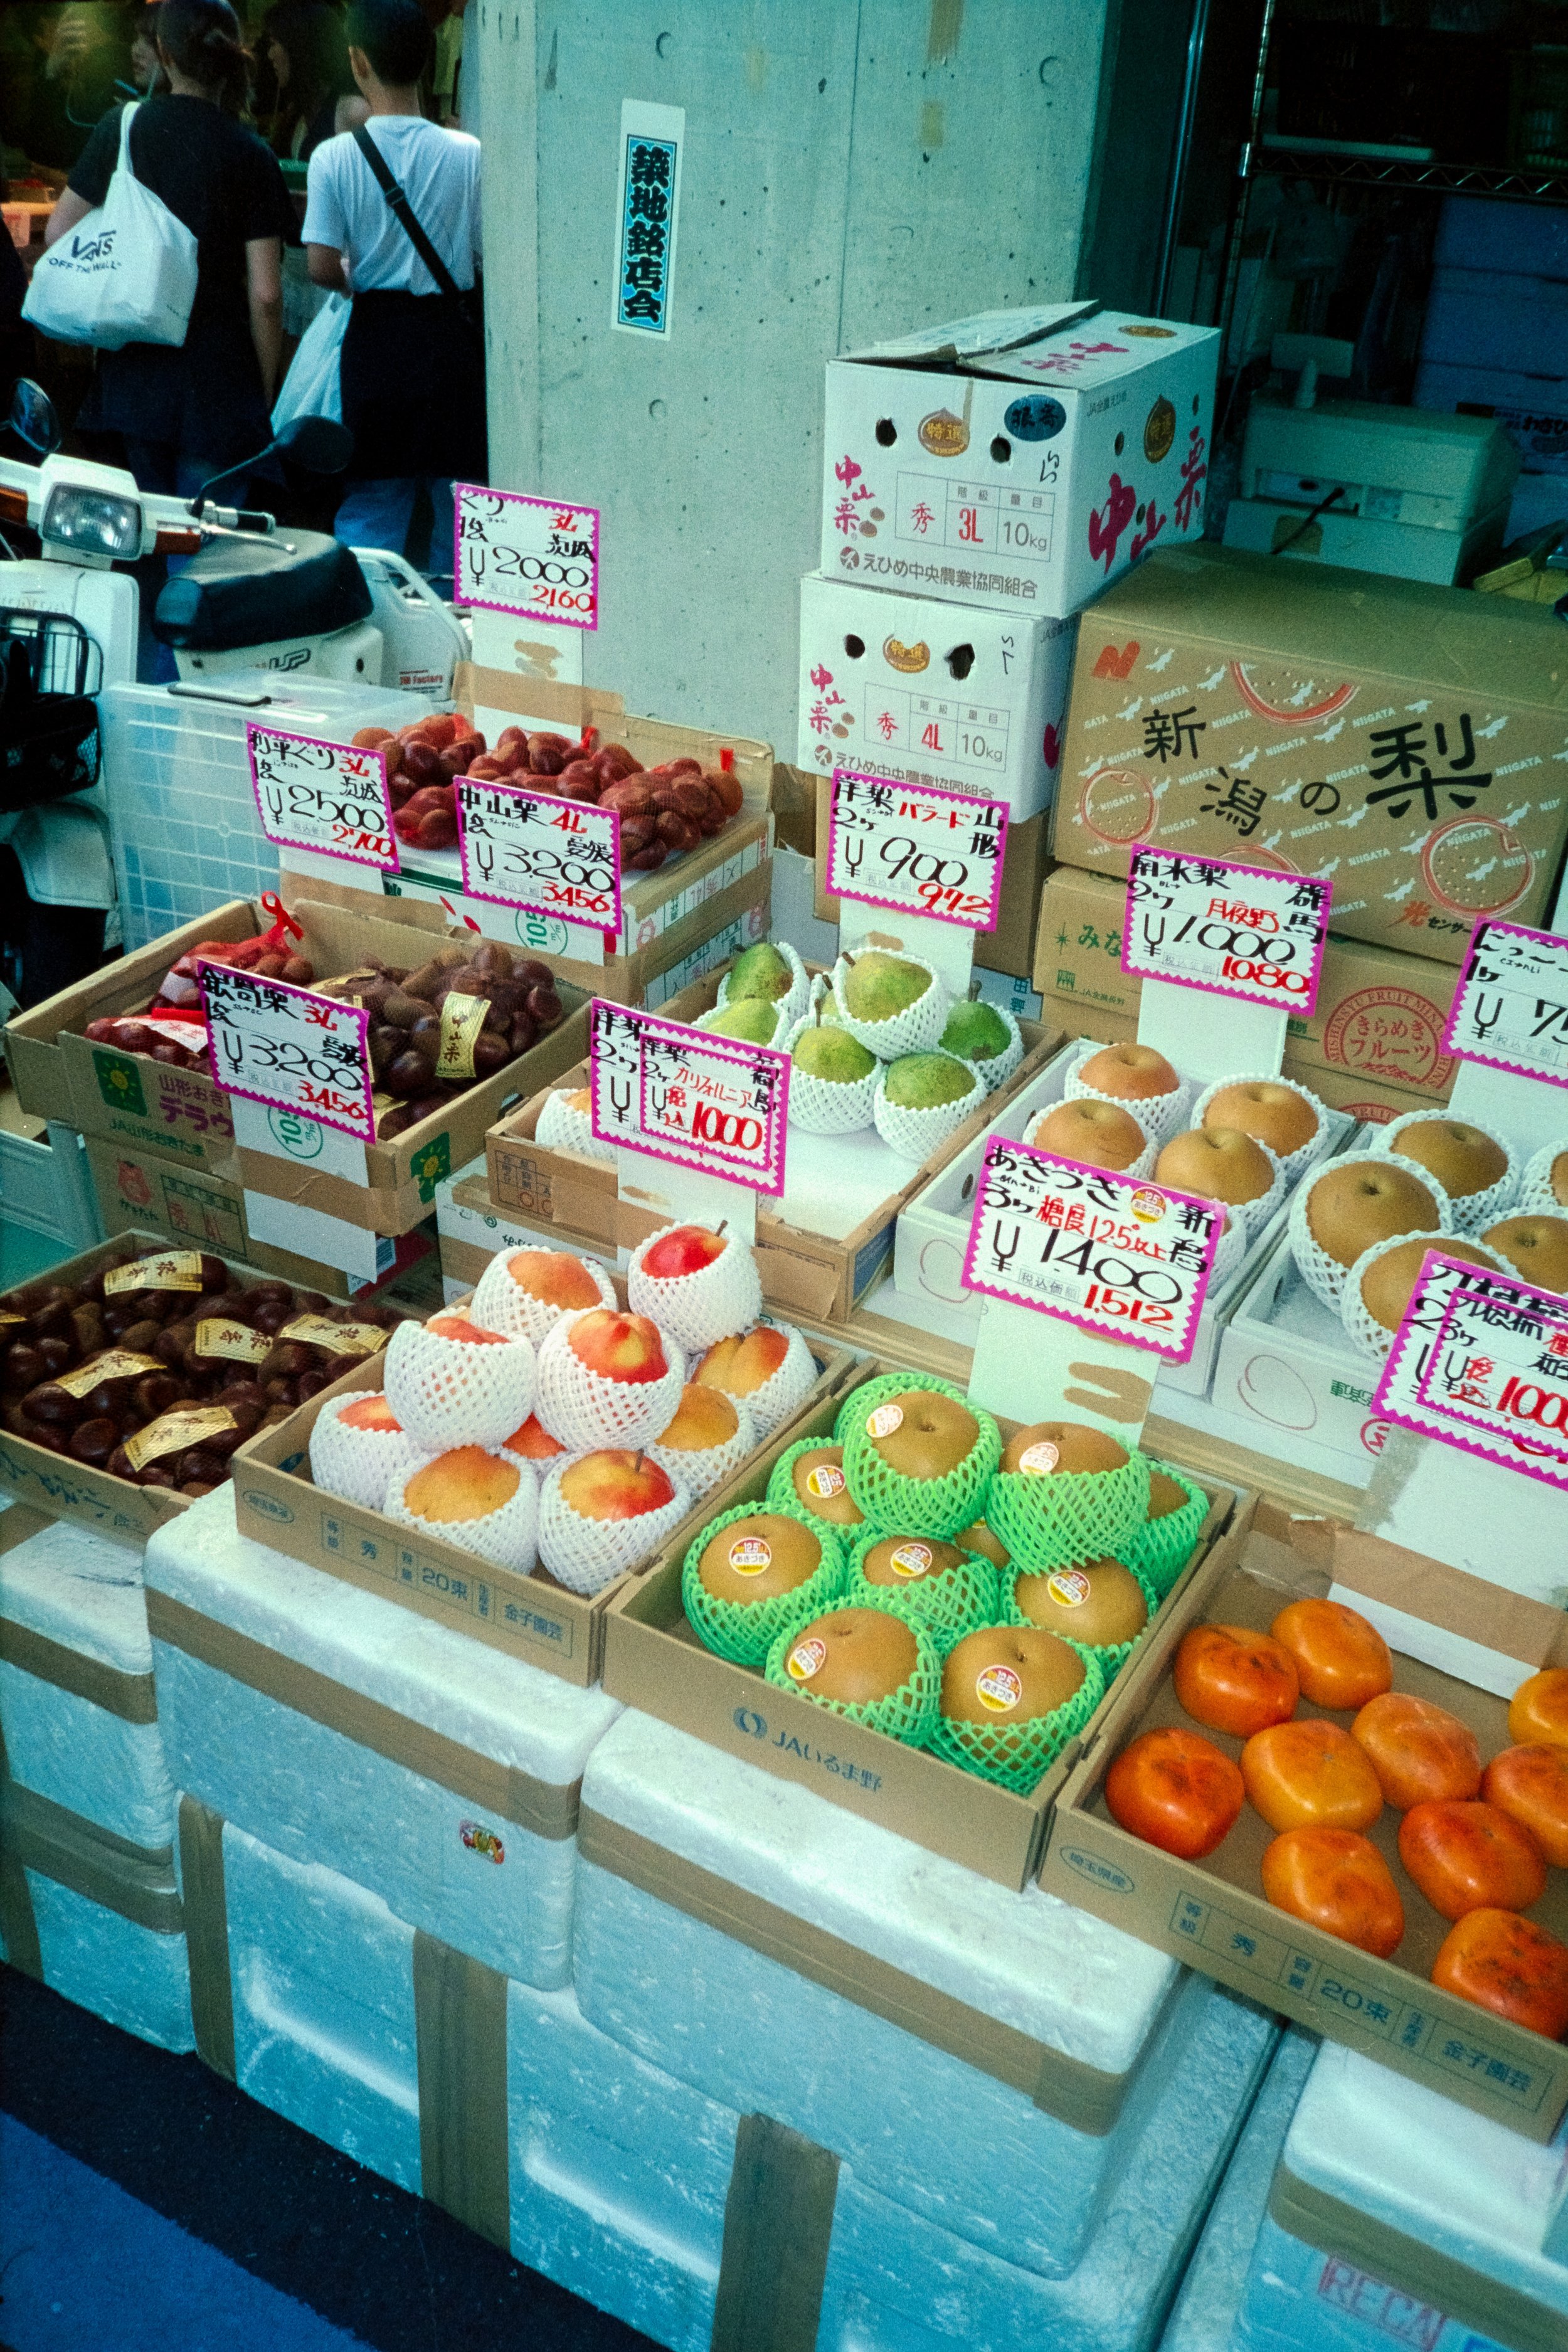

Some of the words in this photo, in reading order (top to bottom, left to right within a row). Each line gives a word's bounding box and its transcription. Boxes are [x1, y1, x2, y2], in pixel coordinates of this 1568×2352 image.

[72, 230, 116, 260] VANS
[629, 144, 671, 323] 築地銘店会
[461, 494, 504, 516] くり
[548, 512, 578, 532] 3L
[834, 454, 876, 534] 中山栗
[911, 502, 935, 534] 秀
[958, 507, 984, 543] 3L
[1004, 521, 1047, 551] 10kg
[863, 553, 1038, 599] えひめ中央農業協同組合
[809, 663, 846, 734] 中山栗
[877, 712, 899, 740] 秀
[921, 723, 944, 751] 4L
[961, 733, 1004, 762] 10kg
[339, 756, 370, 777] 3L
[458, 785, 549, 827] 中山栗
[549, 809, 588, 834] 4L
[834, 775, 896, 813] 洋梨
[899, 801, 971, 829] バラード
[968, 807, 1004, 859] 山形
[1130, 850, 1232, 890] 南水梨
[917, 882, 992, 916] 972
[303, 1004, 338, 1032] 3L
[1357, 1015, 1424, 1041] きらめき
[1350, 1039, 1432, 1064] フルーツ
[674, 1067, 752, 1109] カリフォルニア
[361, 1539, 379, 1560] 秀
[771, 1730, 883, 1793] JAいるま野
[1230, 1932, 1258, 1957] 秀
[1443, 2039, 1532, 2093] 金子園芸
